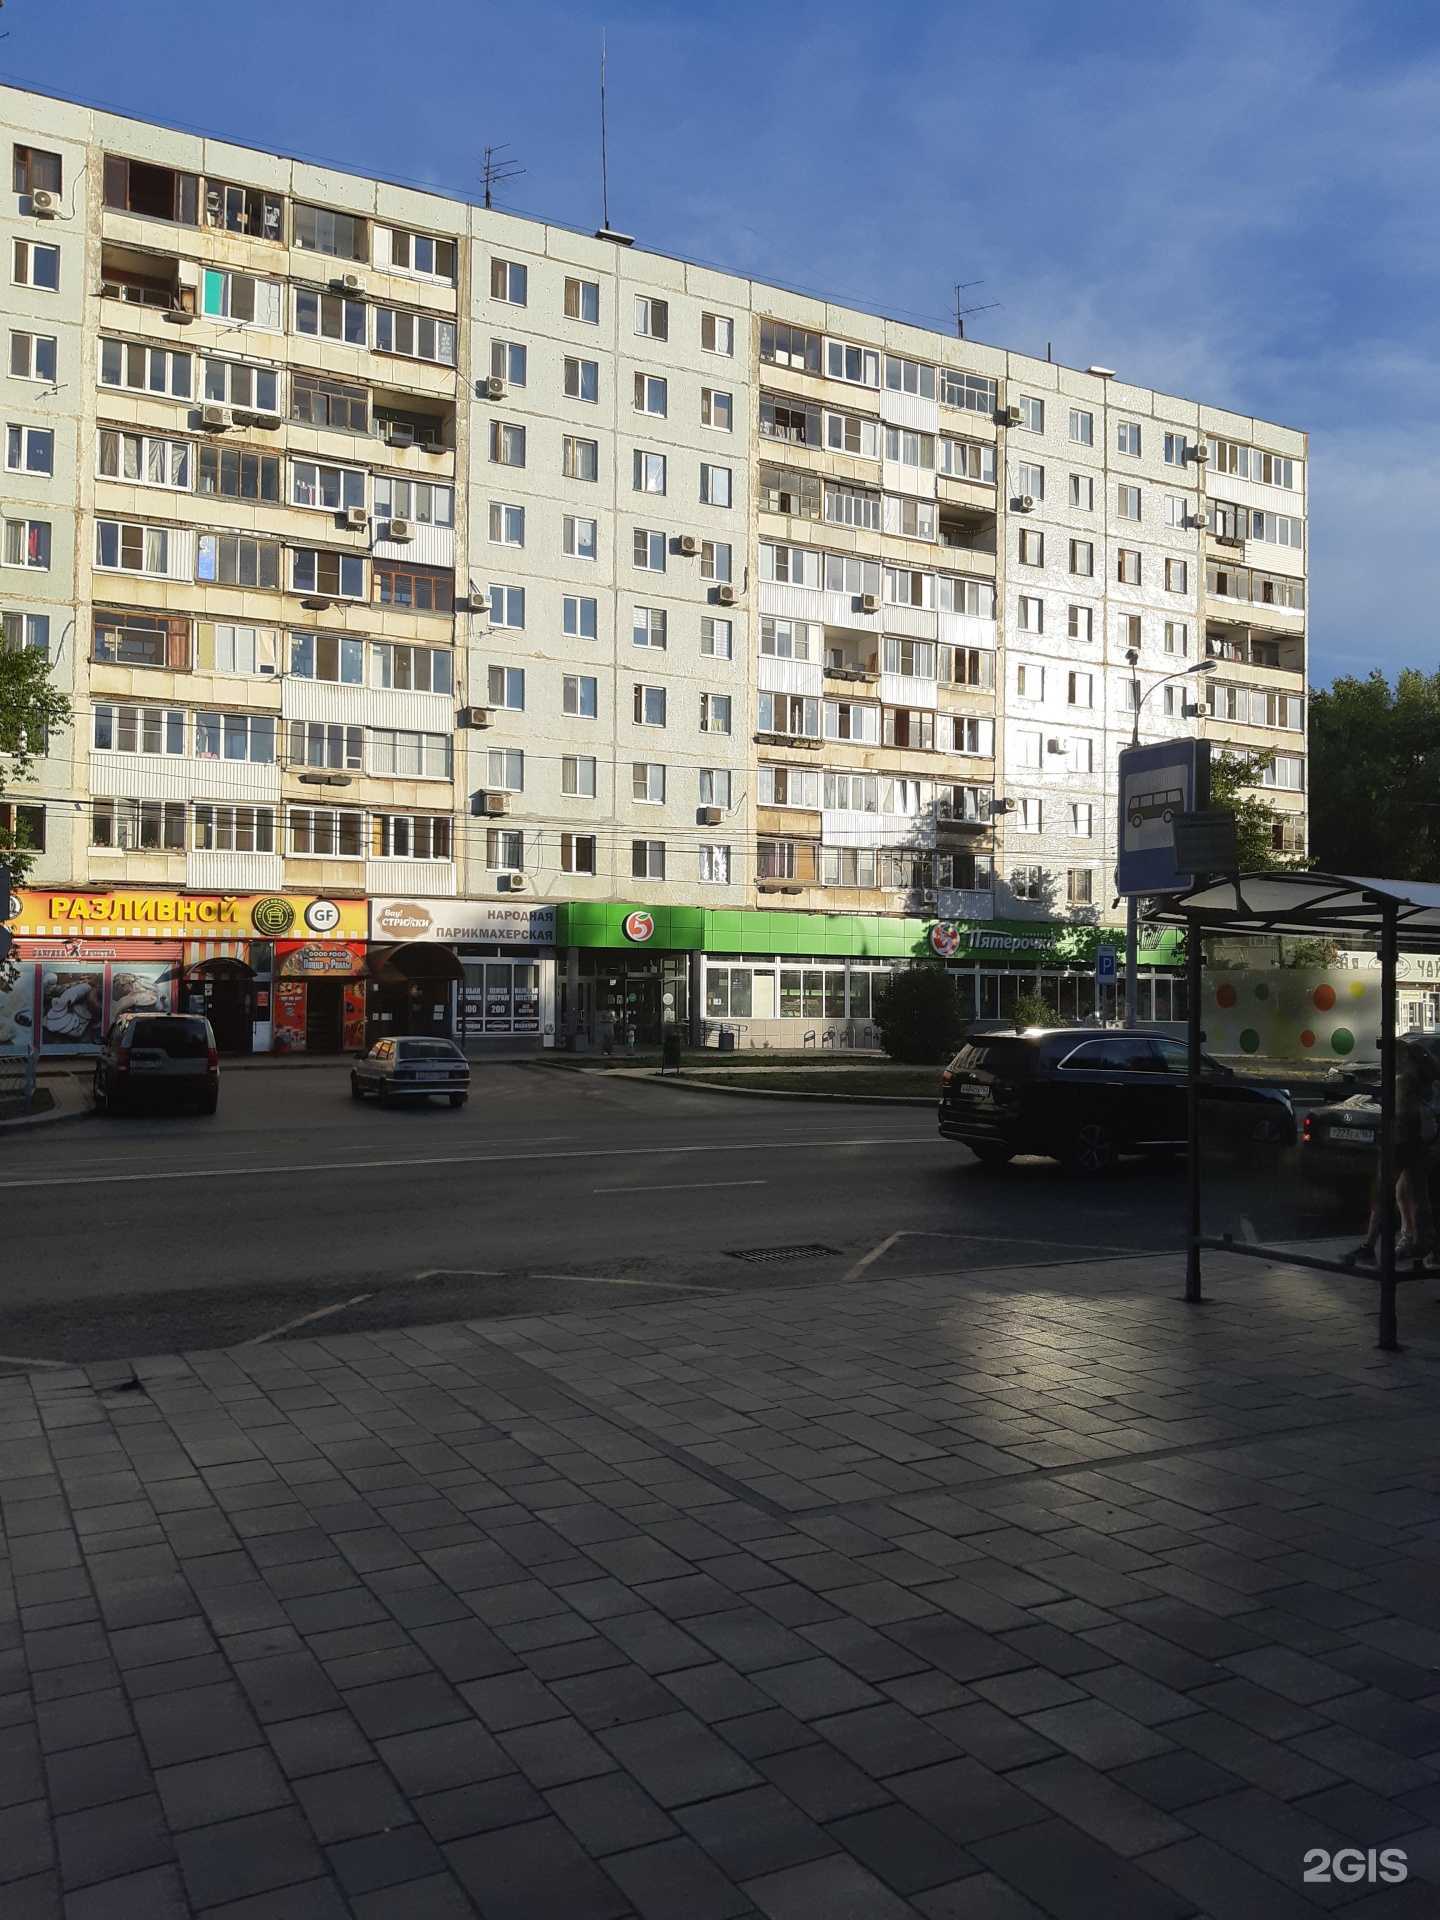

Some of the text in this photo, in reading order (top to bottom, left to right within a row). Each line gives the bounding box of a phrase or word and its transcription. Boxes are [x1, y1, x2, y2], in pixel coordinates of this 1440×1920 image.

[50, 896, 240, 922] РАЗЛИВНОЙ
[314, 909, 334, 922] GF
[487, 910, 553, 922] НАРОДНАЯ
[436, 927, 553, 940] ПАРИКМАХЕРСКАЯ
